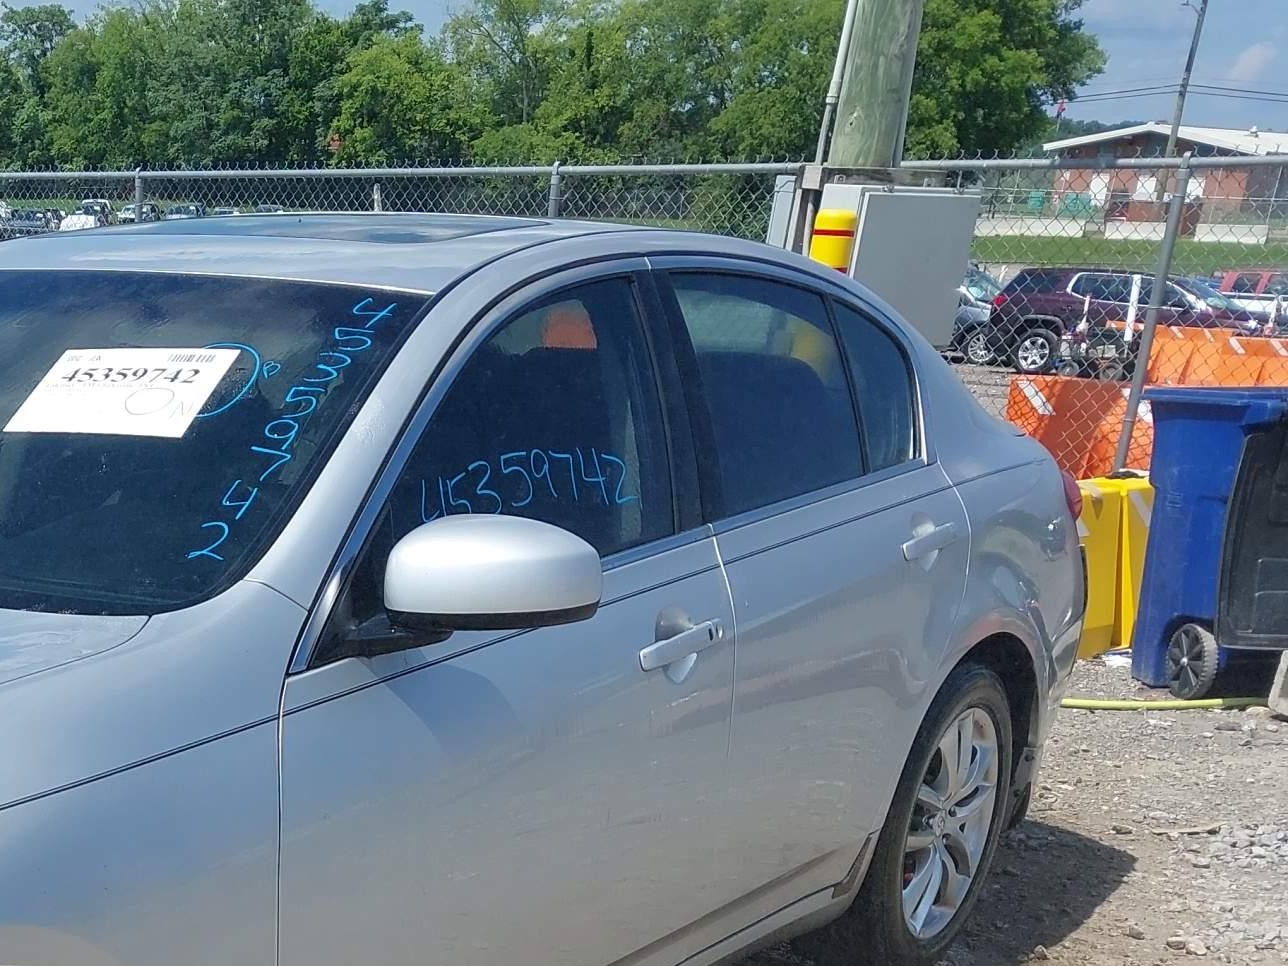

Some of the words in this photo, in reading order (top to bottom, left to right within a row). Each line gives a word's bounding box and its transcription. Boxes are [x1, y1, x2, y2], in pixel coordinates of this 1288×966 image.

[61, 367, 200, 384] 45359742
[185, 297, 397, 561] 24795354
[420, 447, 641, 523] 45359742
